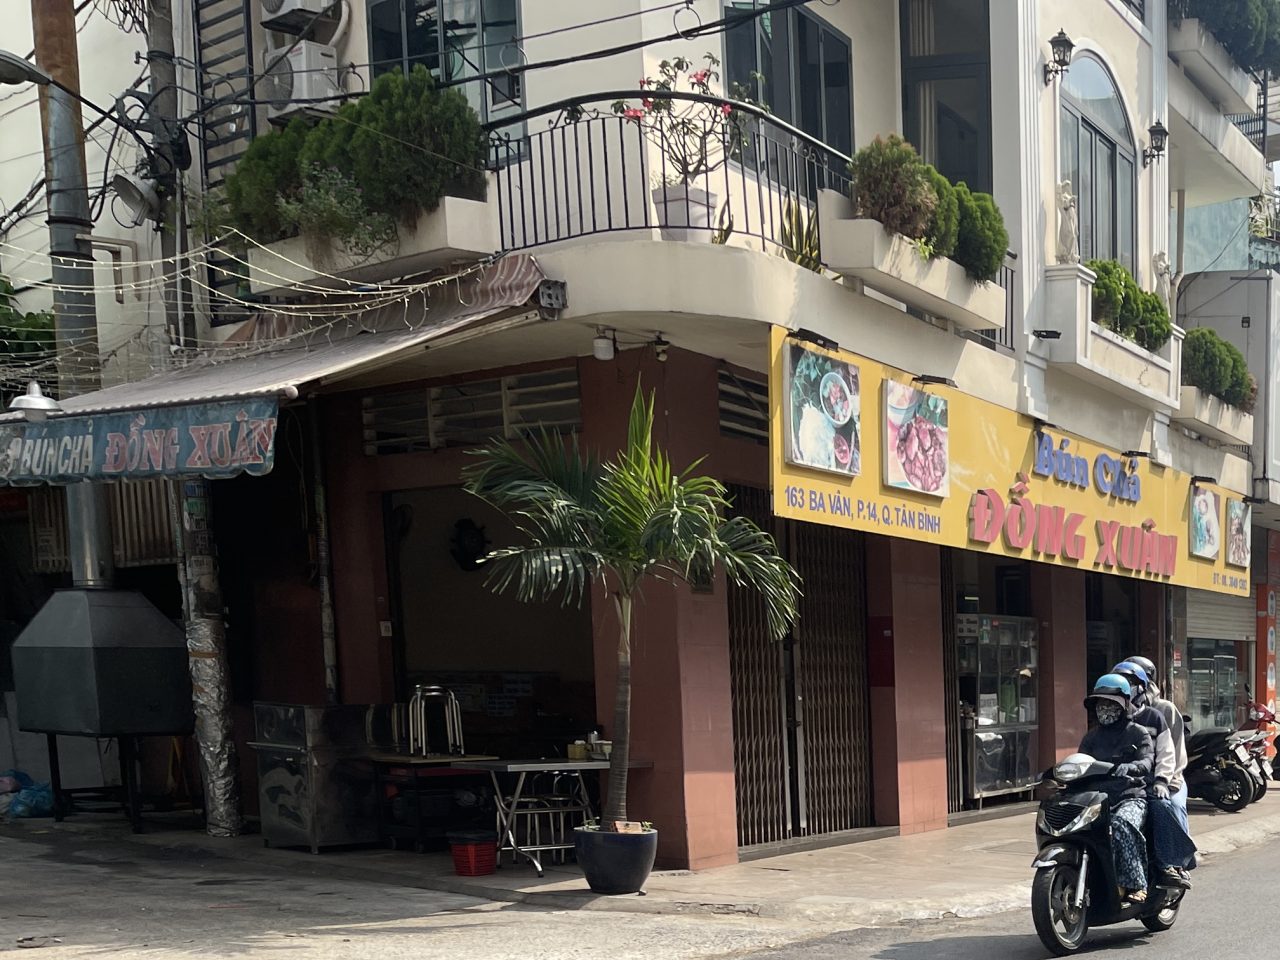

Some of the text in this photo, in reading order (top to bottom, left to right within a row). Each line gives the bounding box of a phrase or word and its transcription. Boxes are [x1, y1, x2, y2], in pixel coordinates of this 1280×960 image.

[102, 413, 180, 473] ĐỒNG
[185, 409, 278, 468] XUÂN
[1034, 429, 1141, 503] Bún Chả
[785, 485, 941, 534] 163 BA VÂN, P.14, Q. TÂN BÌNH
[968, 472, 1178, 577] ĐỒNG XUÂN
